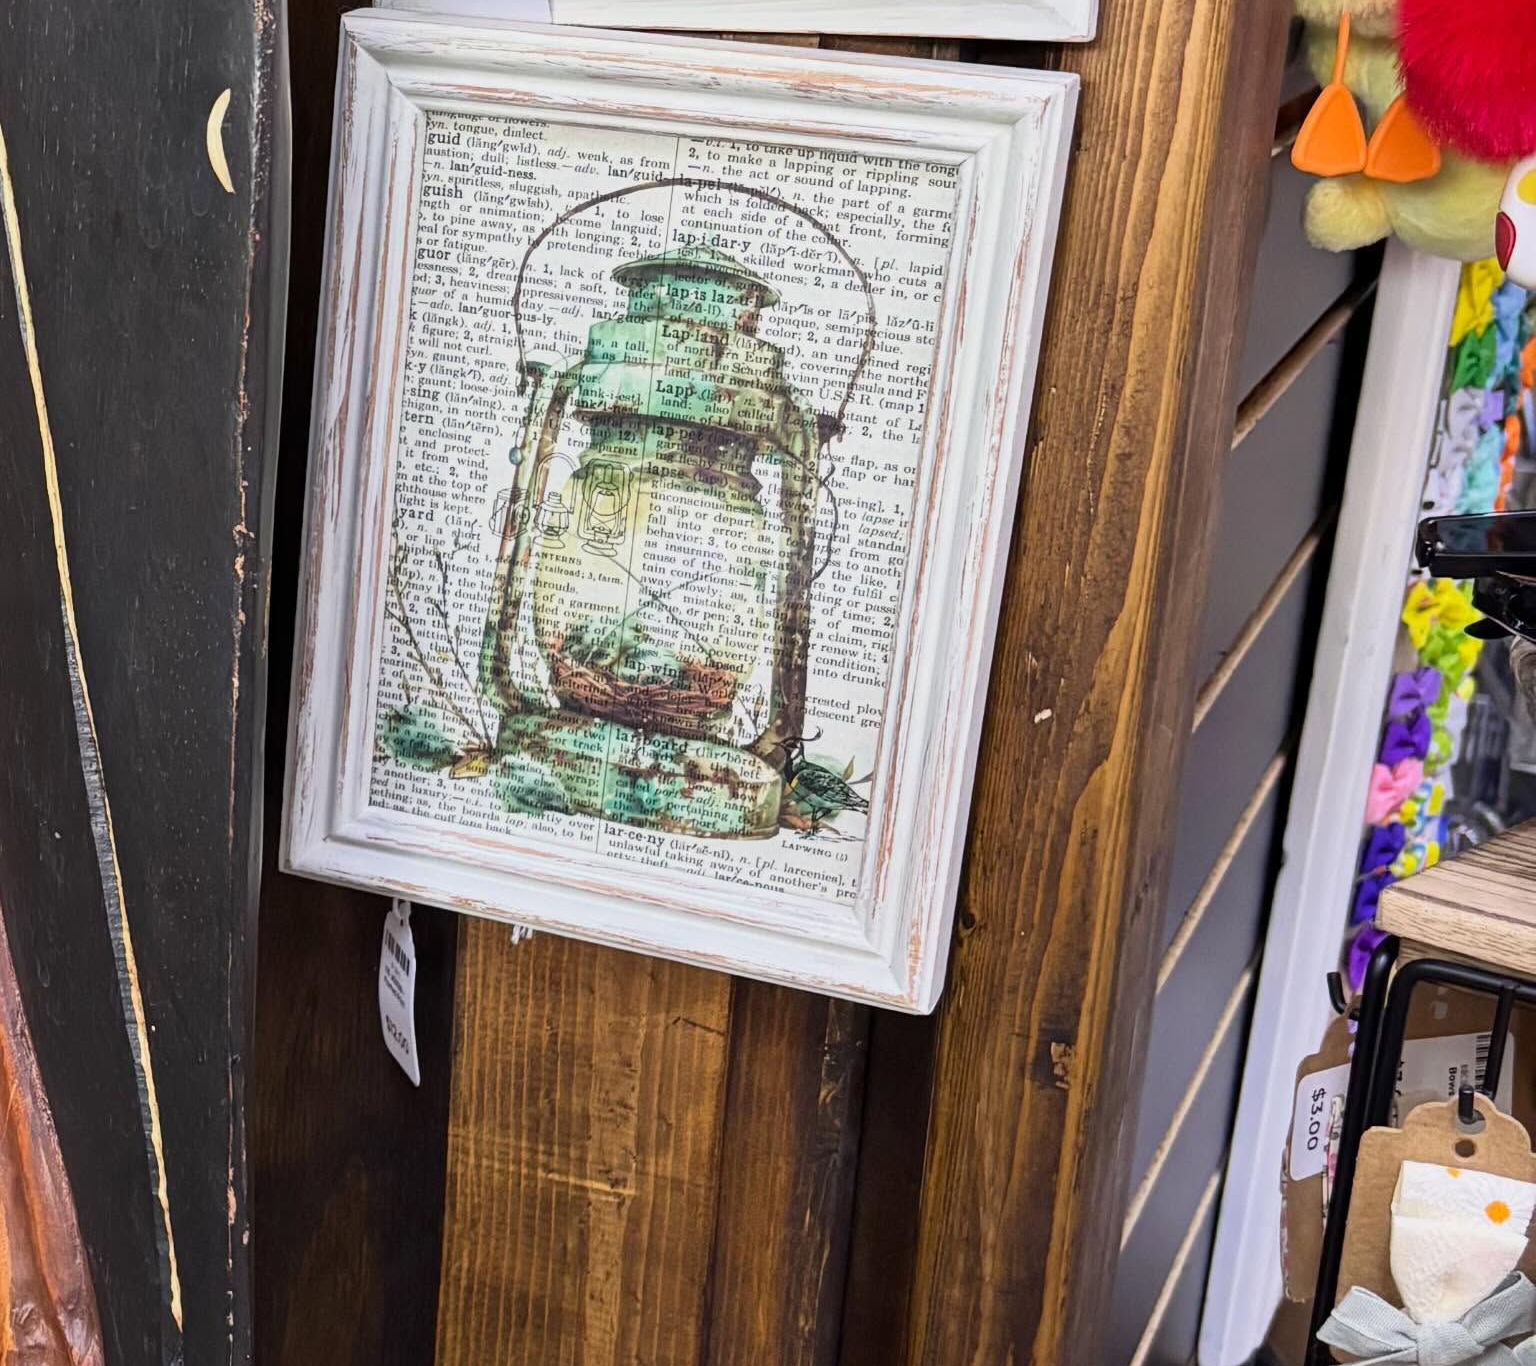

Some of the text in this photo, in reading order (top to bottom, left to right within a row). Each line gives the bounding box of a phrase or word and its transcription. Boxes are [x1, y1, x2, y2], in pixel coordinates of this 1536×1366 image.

[619, 156, 633, 165] as
[639, 156, 670, 170] from
[707, 150, 720, 160] to
[727, 153, 762, 166] make
[768, 159, 776, 167] a
[784, 157, 834, 176] lapping
[842, 167, 857, 176] or
[865, 167, 919, 186] rippling
[722, 165, 911, 199] the act or sound of lapping.
[432, 212, 444, 221] to
[450, 215, 475, 226] pine
[405, 446, 414, 458] it
[421, 449, 448, 463] from
[411, 474, 488, 493] at the top of
[399, 493, 472, 515] light is kept.
[649, 502, 755, 528] to slip or depart
[780, 839, 833, 859] LAPWING
[608, 839, 827, 892] unlawful taking away of another's
[1447, 1065, 1459, 1097] Bows
[1305, 1087, 1327, 1152] $3.00
